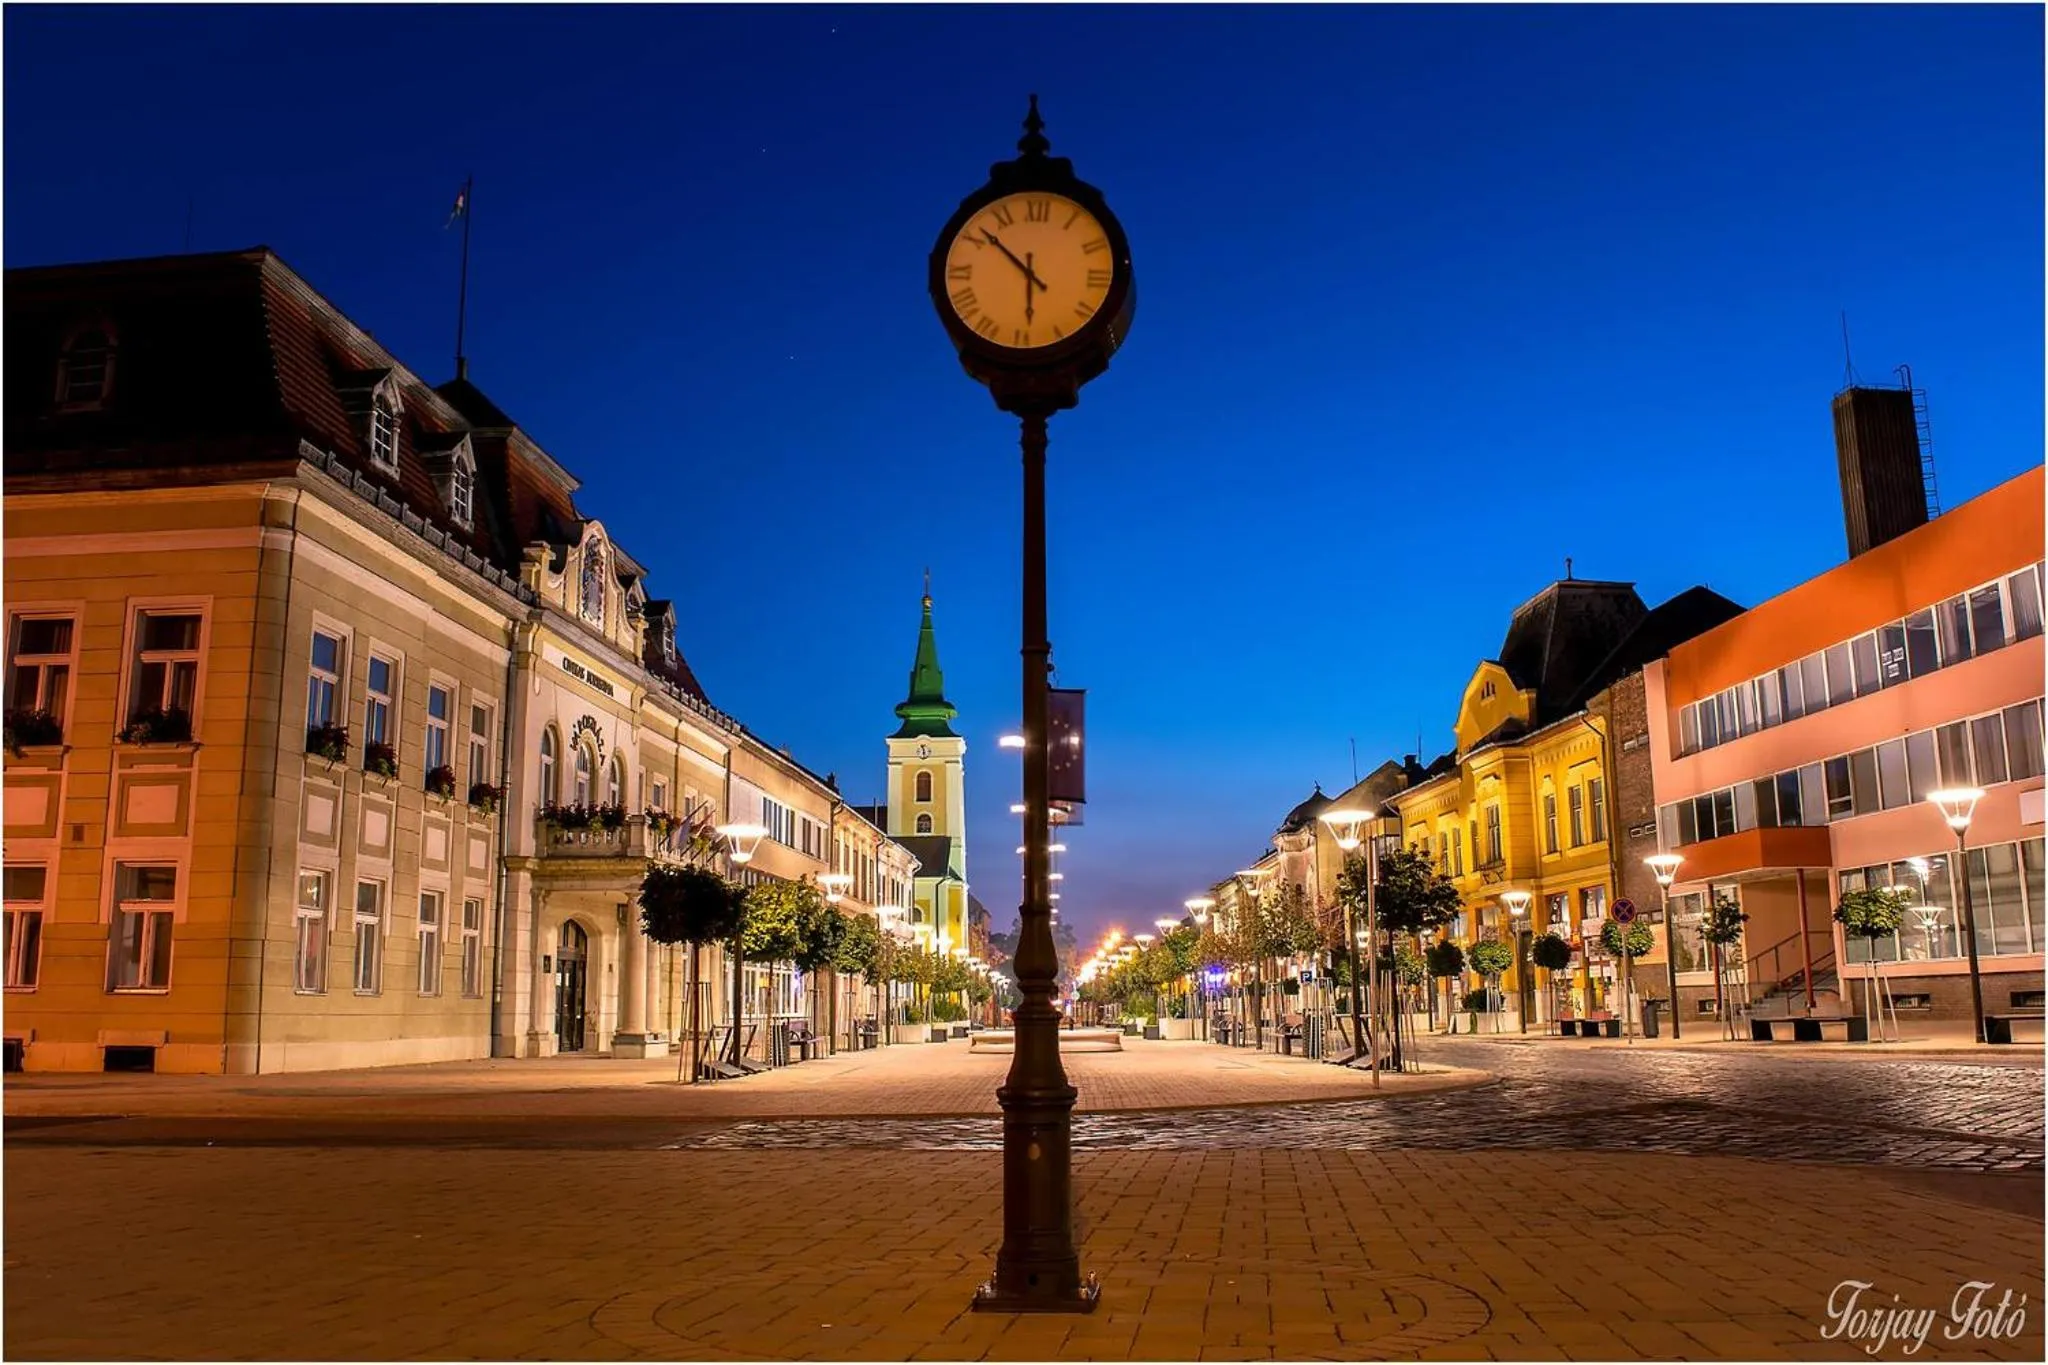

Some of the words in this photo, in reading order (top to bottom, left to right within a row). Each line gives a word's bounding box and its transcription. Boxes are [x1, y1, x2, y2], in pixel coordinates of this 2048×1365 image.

[990, 204, 1014, 230] XI
[1024, 200, 1050, 223] XII
[1081, 238, 1107, 256] II
[1087, 268, 1111, 288] III
